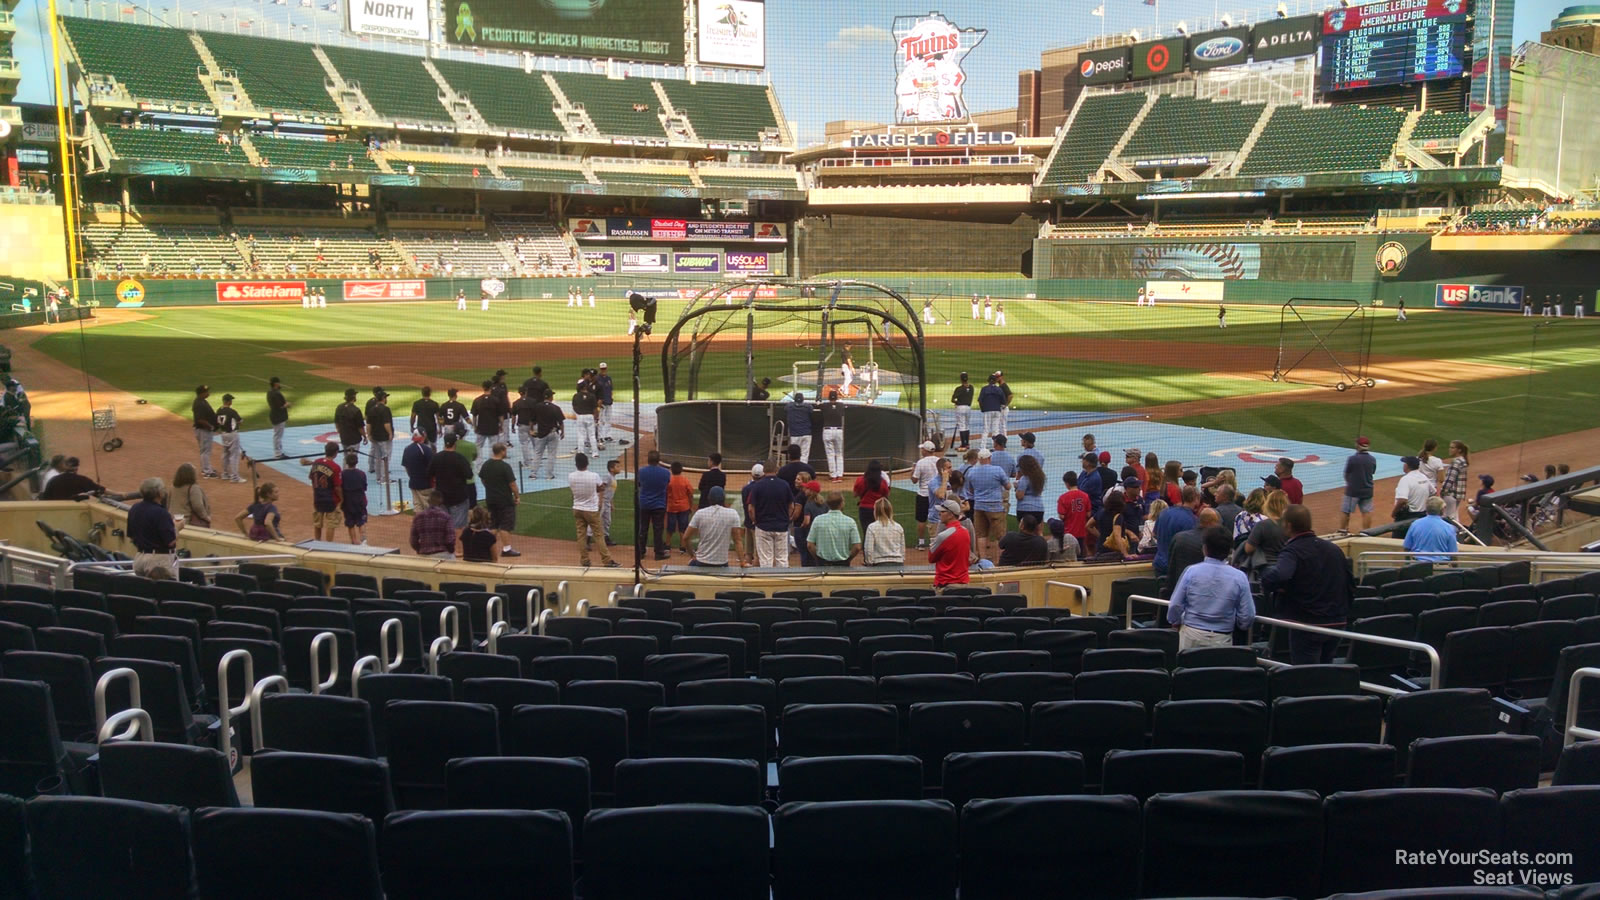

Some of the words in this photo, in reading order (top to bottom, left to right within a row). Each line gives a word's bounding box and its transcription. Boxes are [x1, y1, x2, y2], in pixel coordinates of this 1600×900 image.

[363, 0, 413, 20] NORTH
[1359, 14, 1396, 27] AMERICAN
[1397, 9, 1426, 21] LEAGUE
[482, 27, 537, 44] PEDIATRIC
[538, 32, 578, 47] CANCER
[580, 35, 640, 52] AWARENESS
[641, 41, 670, 55] NIGHT
[1270, 30, 1313, 46] DELTA
[901, 32, 958, 61] Twins
[1203, 41, 1233, 57] Ford
[1095, 56, 1124, 73] pepsi
[851, 132, 933, 147] TARGET
[954, 131, 1017, 145] FIELD
[653, 219, 673, 227] Student
[611, 228, 649, 236] RASMUSSEN
[676, 256, 718, 266] SUBWAY
[446, 408, 455, 419] 5
[1071, 498, 1085, 513] 15
